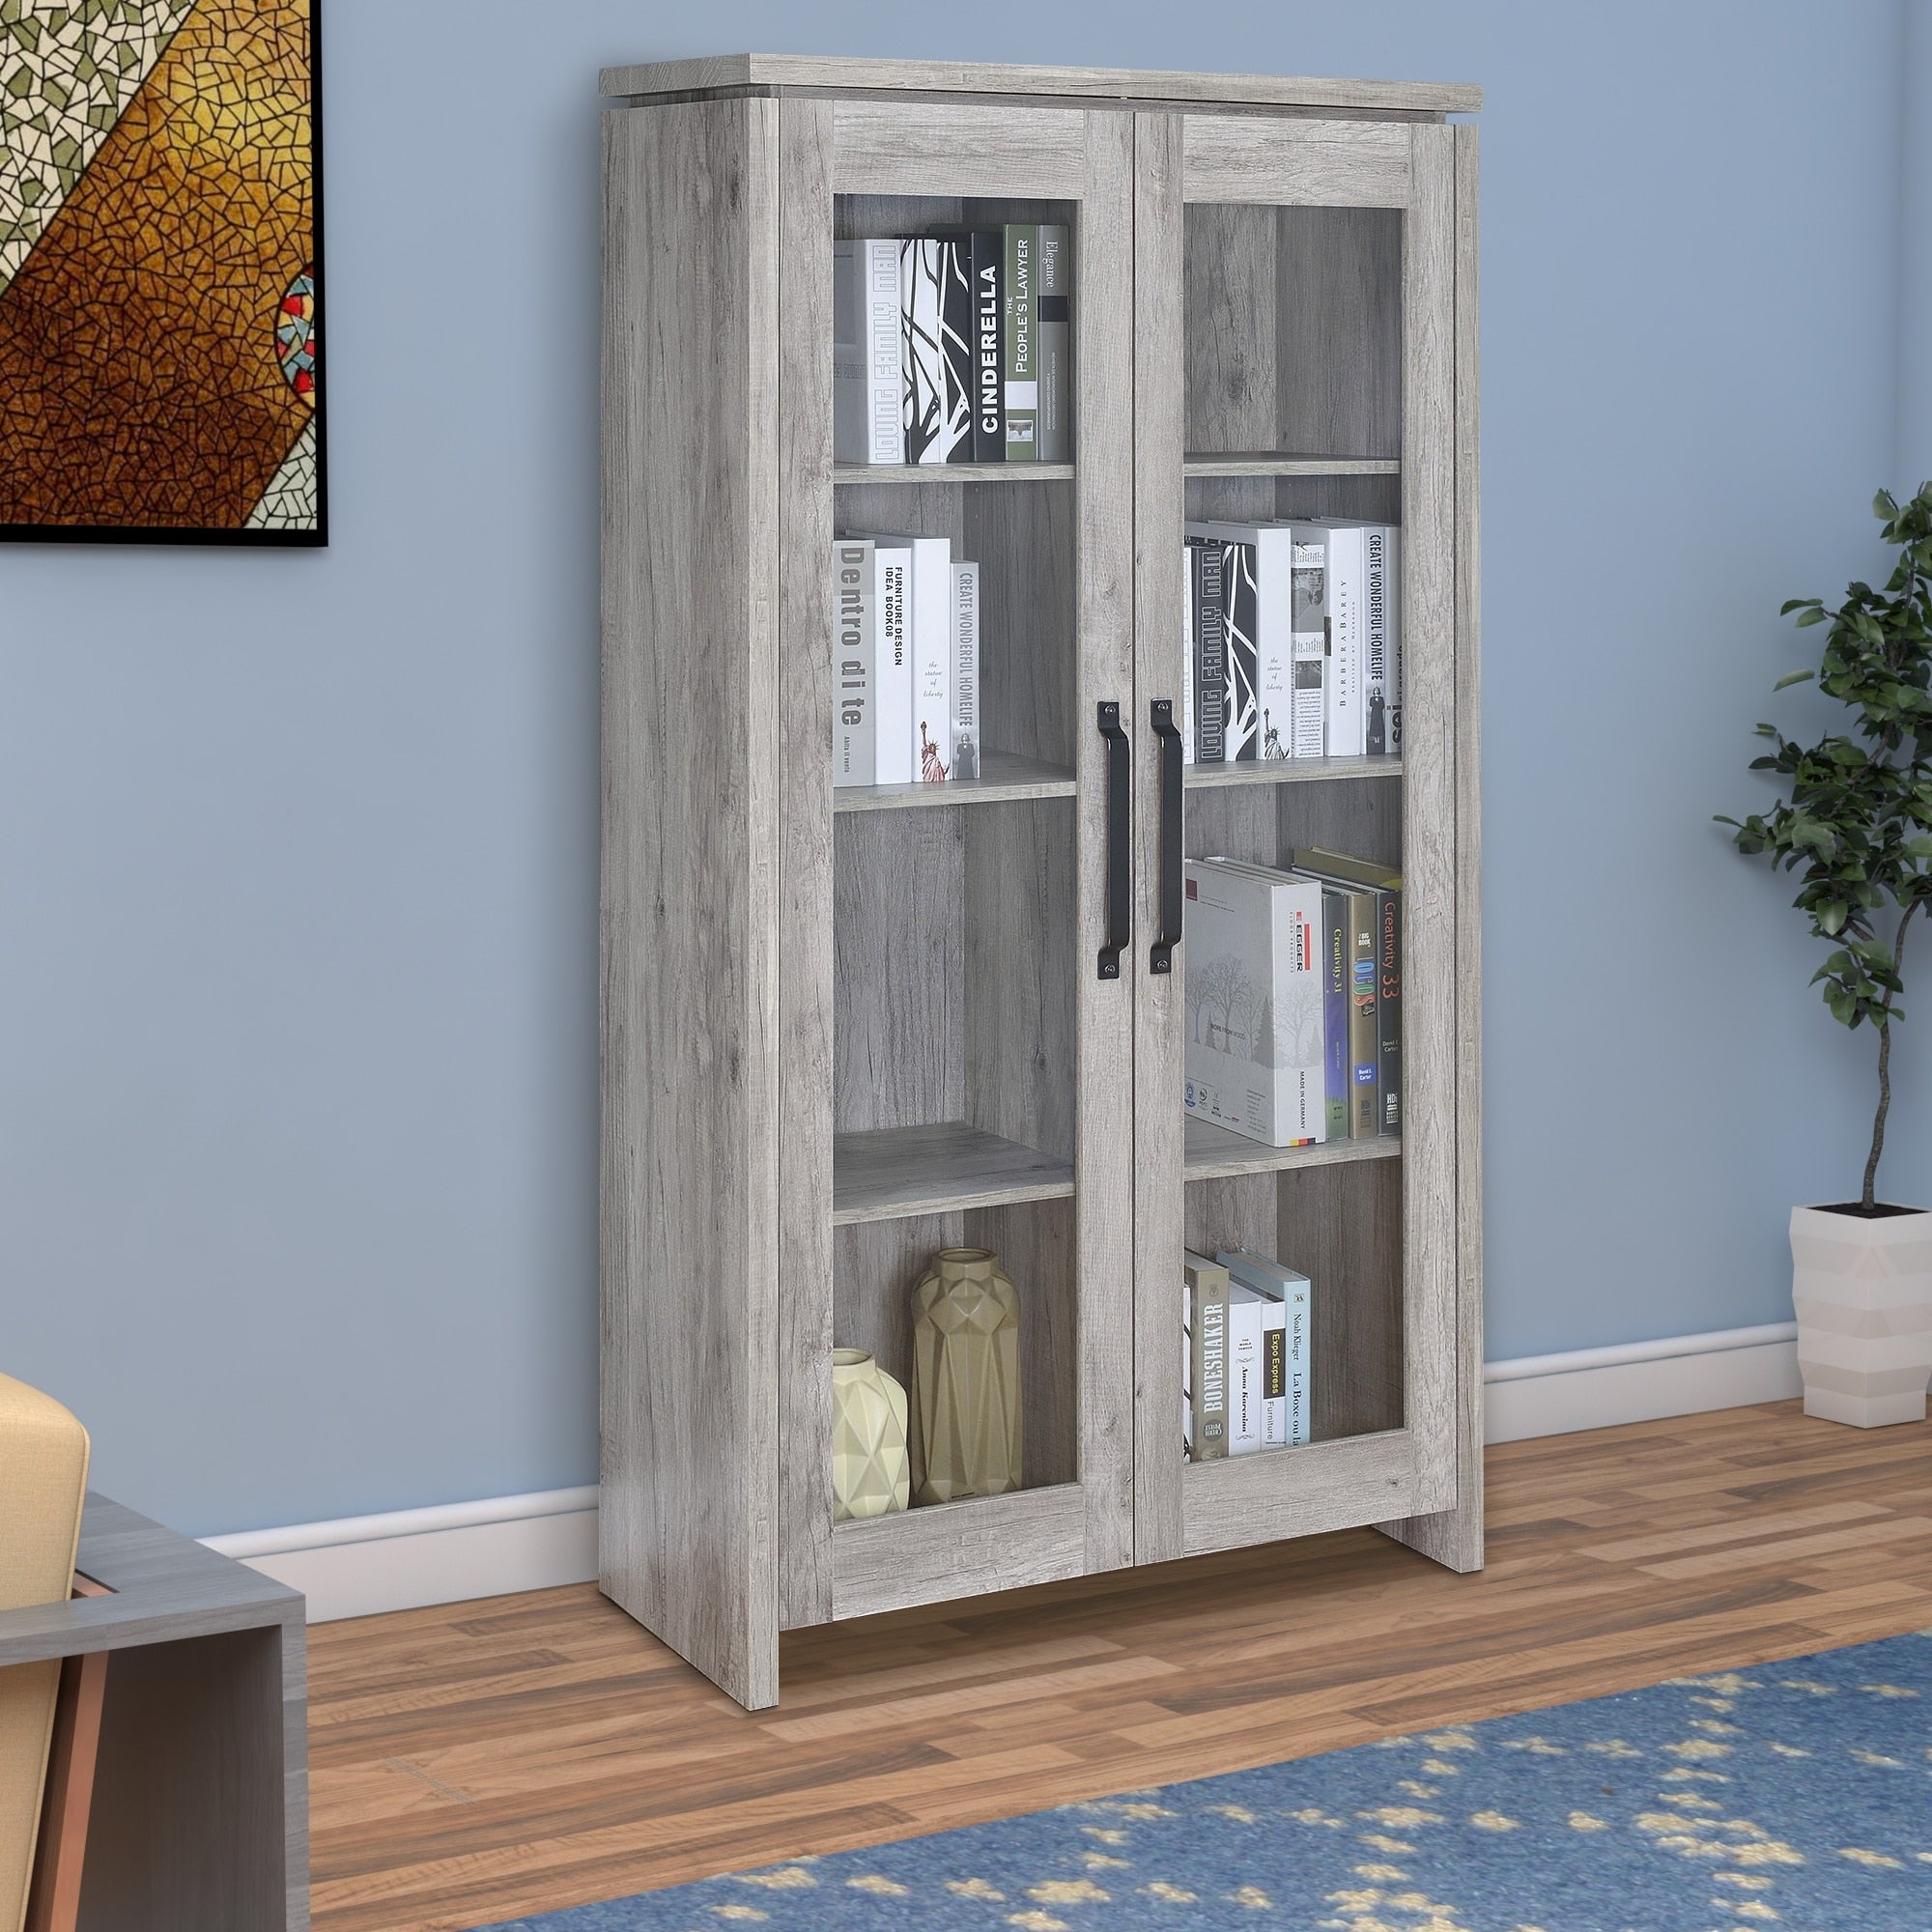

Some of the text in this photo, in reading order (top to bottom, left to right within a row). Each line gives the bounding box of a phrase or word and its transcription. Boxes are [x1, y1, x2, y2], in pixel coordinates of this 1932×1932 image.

[1042, 242, 1059, 288] Elegance
[1015, 239, 1029, 373] PEOPLE'S LAWYER
[980, 265, 999, 434] CINDERELLA
[840, 547, 866, 725] Dentro di te
[885, 567, 894, 638] IDEA BOOK08
[1369, 534, 1383, 681] CREATE WONDERFUL HOMELIFE
[959, 573, 973, 726] CREATE WONDERFUL HOMELIFE
[923, 690, 943, 699] liberty
[1333, 928, 1342, 993] Creativity 31
[1382, 902, 1400, 998] Creativity 33
[1204, 1303, 1223, 1413] BONESHAKER
[1271, 1333, 1280, 1394] Expo Express
[1292, 1336, 1301, 1360] Klieger
[1293, 1373, 1301, 1386] La
[1293, 1420, 1299, 1434] ou
[1293, 1437, 1301, 1446] la
